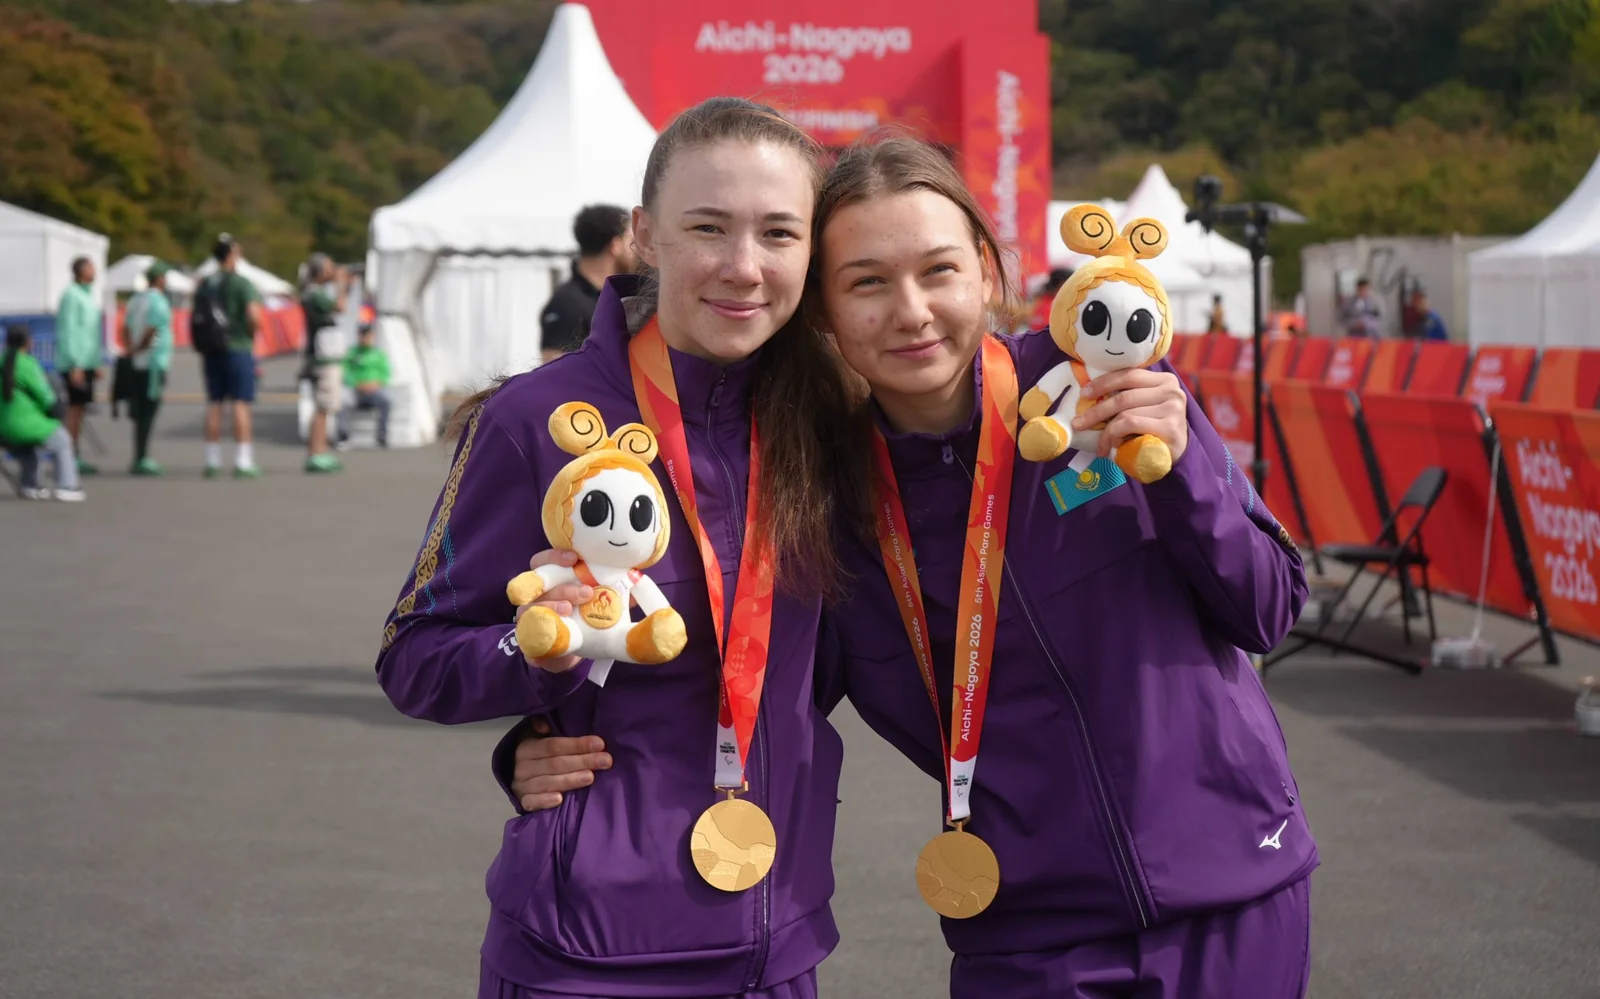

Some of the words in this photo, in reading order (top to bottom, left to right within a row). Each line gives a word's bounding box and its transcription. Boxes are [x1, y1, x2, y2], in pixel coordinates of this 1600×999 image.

[695, 20, 911, 60] Aichi-Nagoya
[763, 53, 844, 84] 2026
[1516, 437, 1573, 491] Aichi-
[983, 494, 995, 529] Games
[980, 532, 990, 555] Para
[899, 563, 909, 588] Asian
[976, 557, 986, 584] Asian
[1545, 552, 1598, 605] 2026
[974, 587, 983, 604] 5th
[912, 617, 924, 649] 2026
[969, 614, 982, 648] 2026
[961, 651, 980, 741] Aichi-Nagoya
